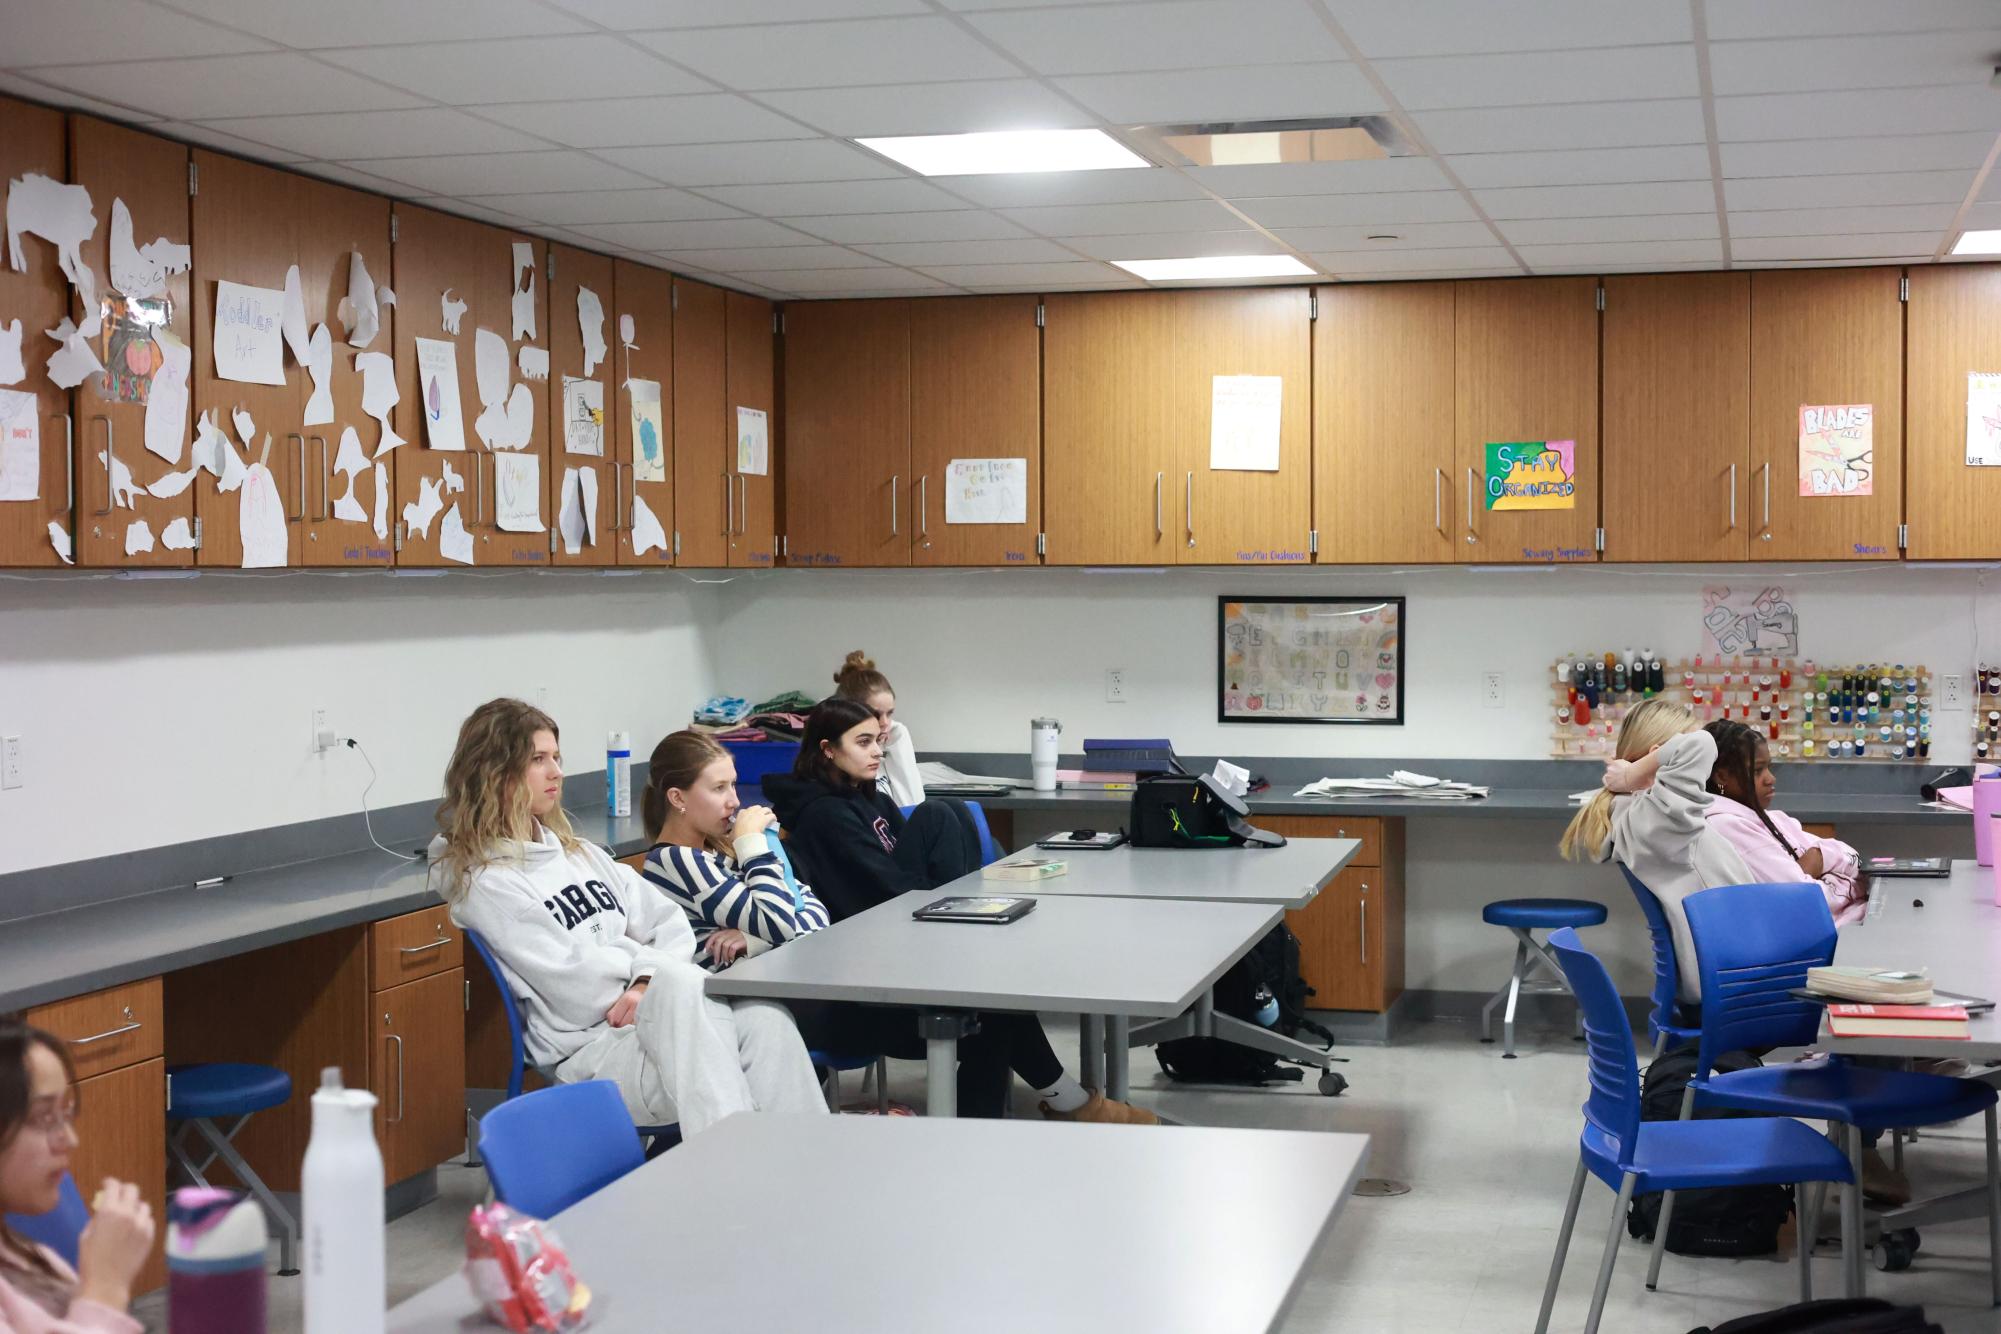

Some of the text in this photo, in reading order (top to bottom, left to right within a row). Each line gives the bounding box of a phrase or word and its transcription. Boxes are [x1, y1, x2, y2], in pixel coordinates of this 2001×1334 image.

[1804, 406, 1869, 435] BLADES
[1841, 429, 1863, 439] ARE
[1967, 456, 1983, 465] USE
[1488, 476, 1575, 497] ORGANIZED
[1811, 467, 1860, 494] BAD
[1270, 549, 1305, 561] Cushions
[1522, 546, 1592, 561] Sewing Supplies
[1854, 543, 1888, 555] Shears
